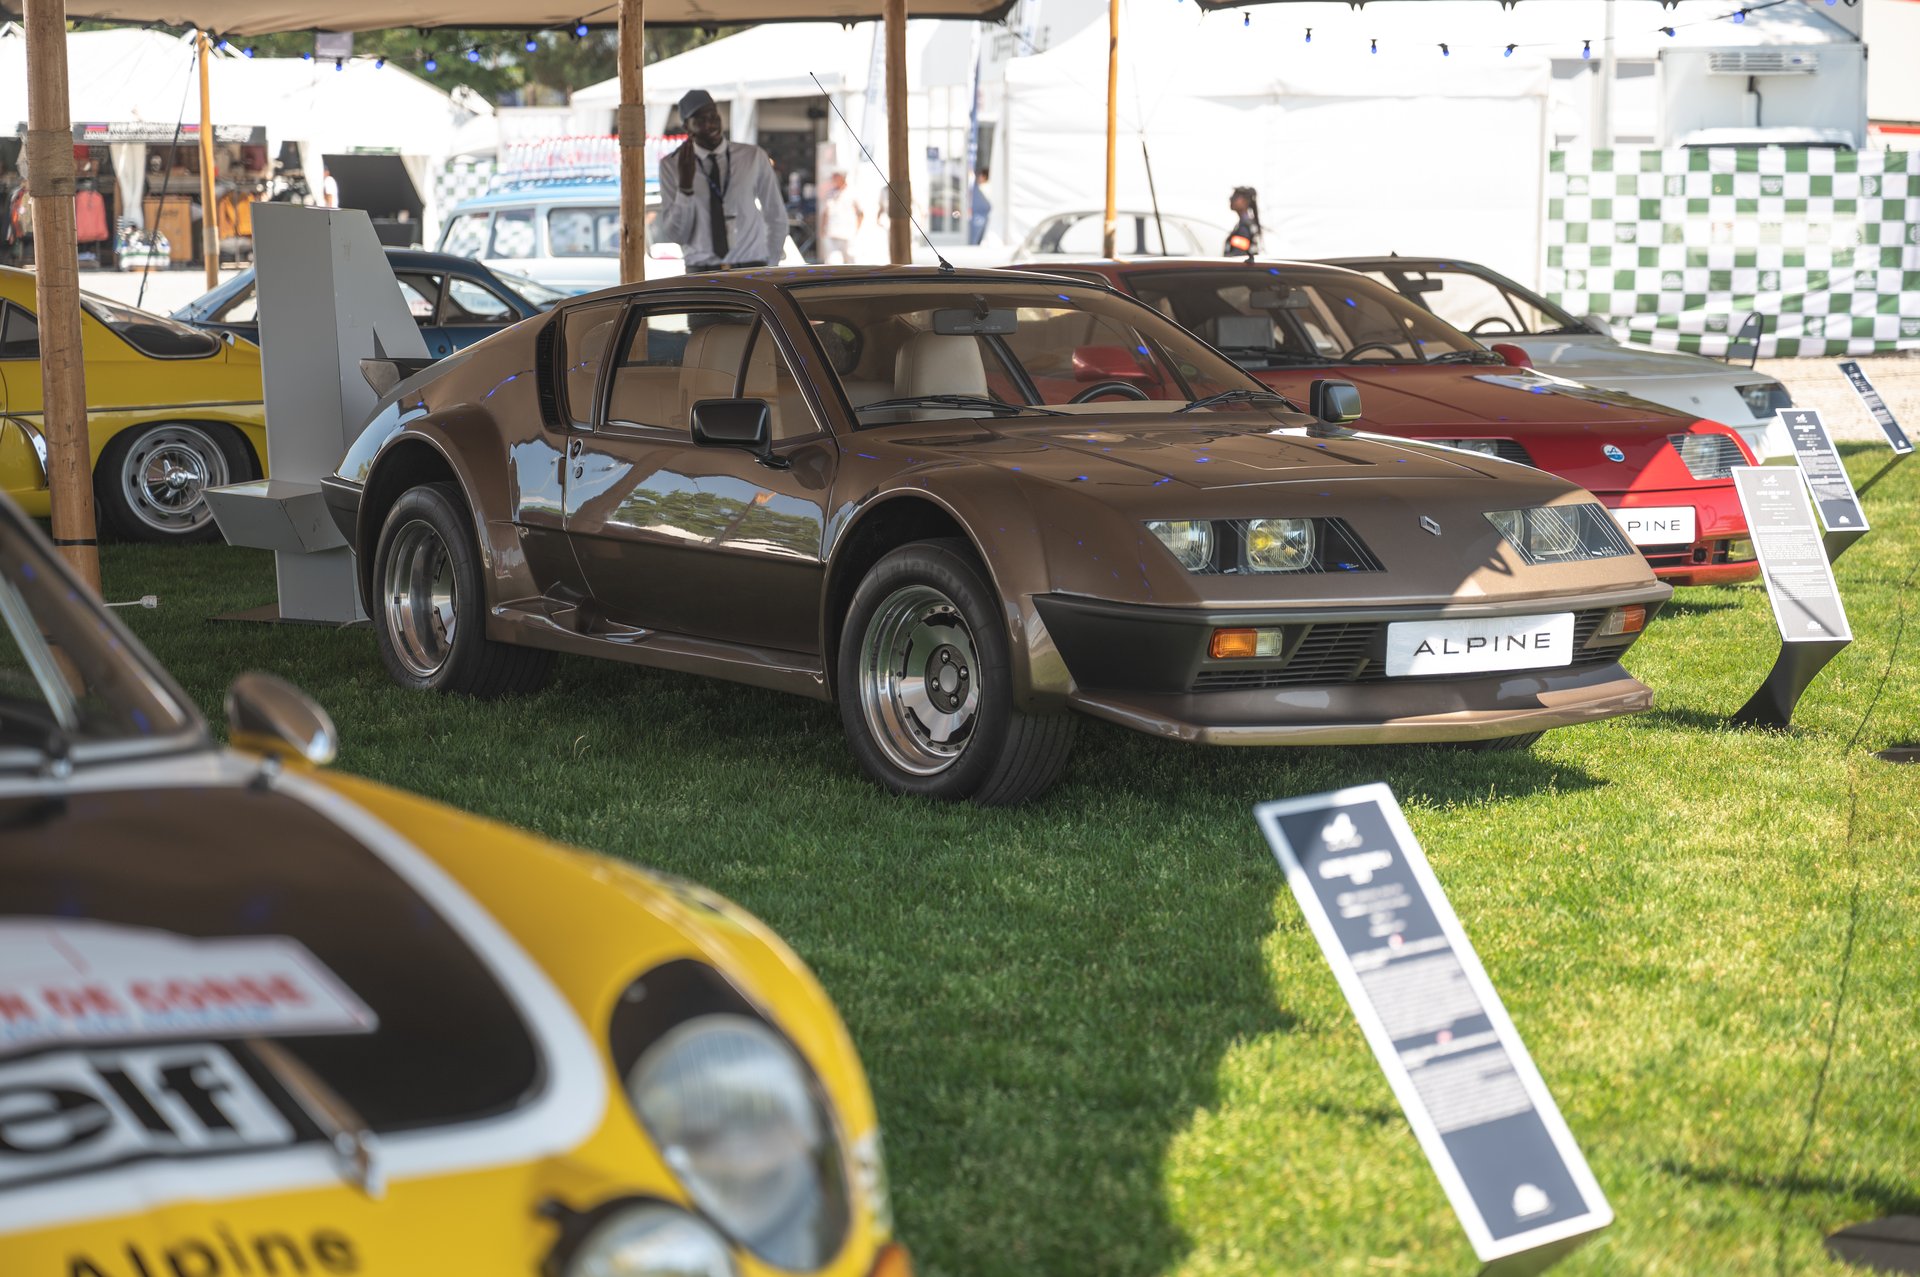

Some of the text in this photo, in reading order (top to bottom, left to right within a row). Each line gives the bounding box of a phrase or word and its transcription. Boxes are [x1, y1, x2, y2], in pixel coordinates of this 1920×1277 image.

[1627, 519, 1681, 532] PINE
[1413, 632, 1551, 657] ALPINE
[0, 1059, 238, 1155] elf
[64, 1219, 361, 1277] Alpine
